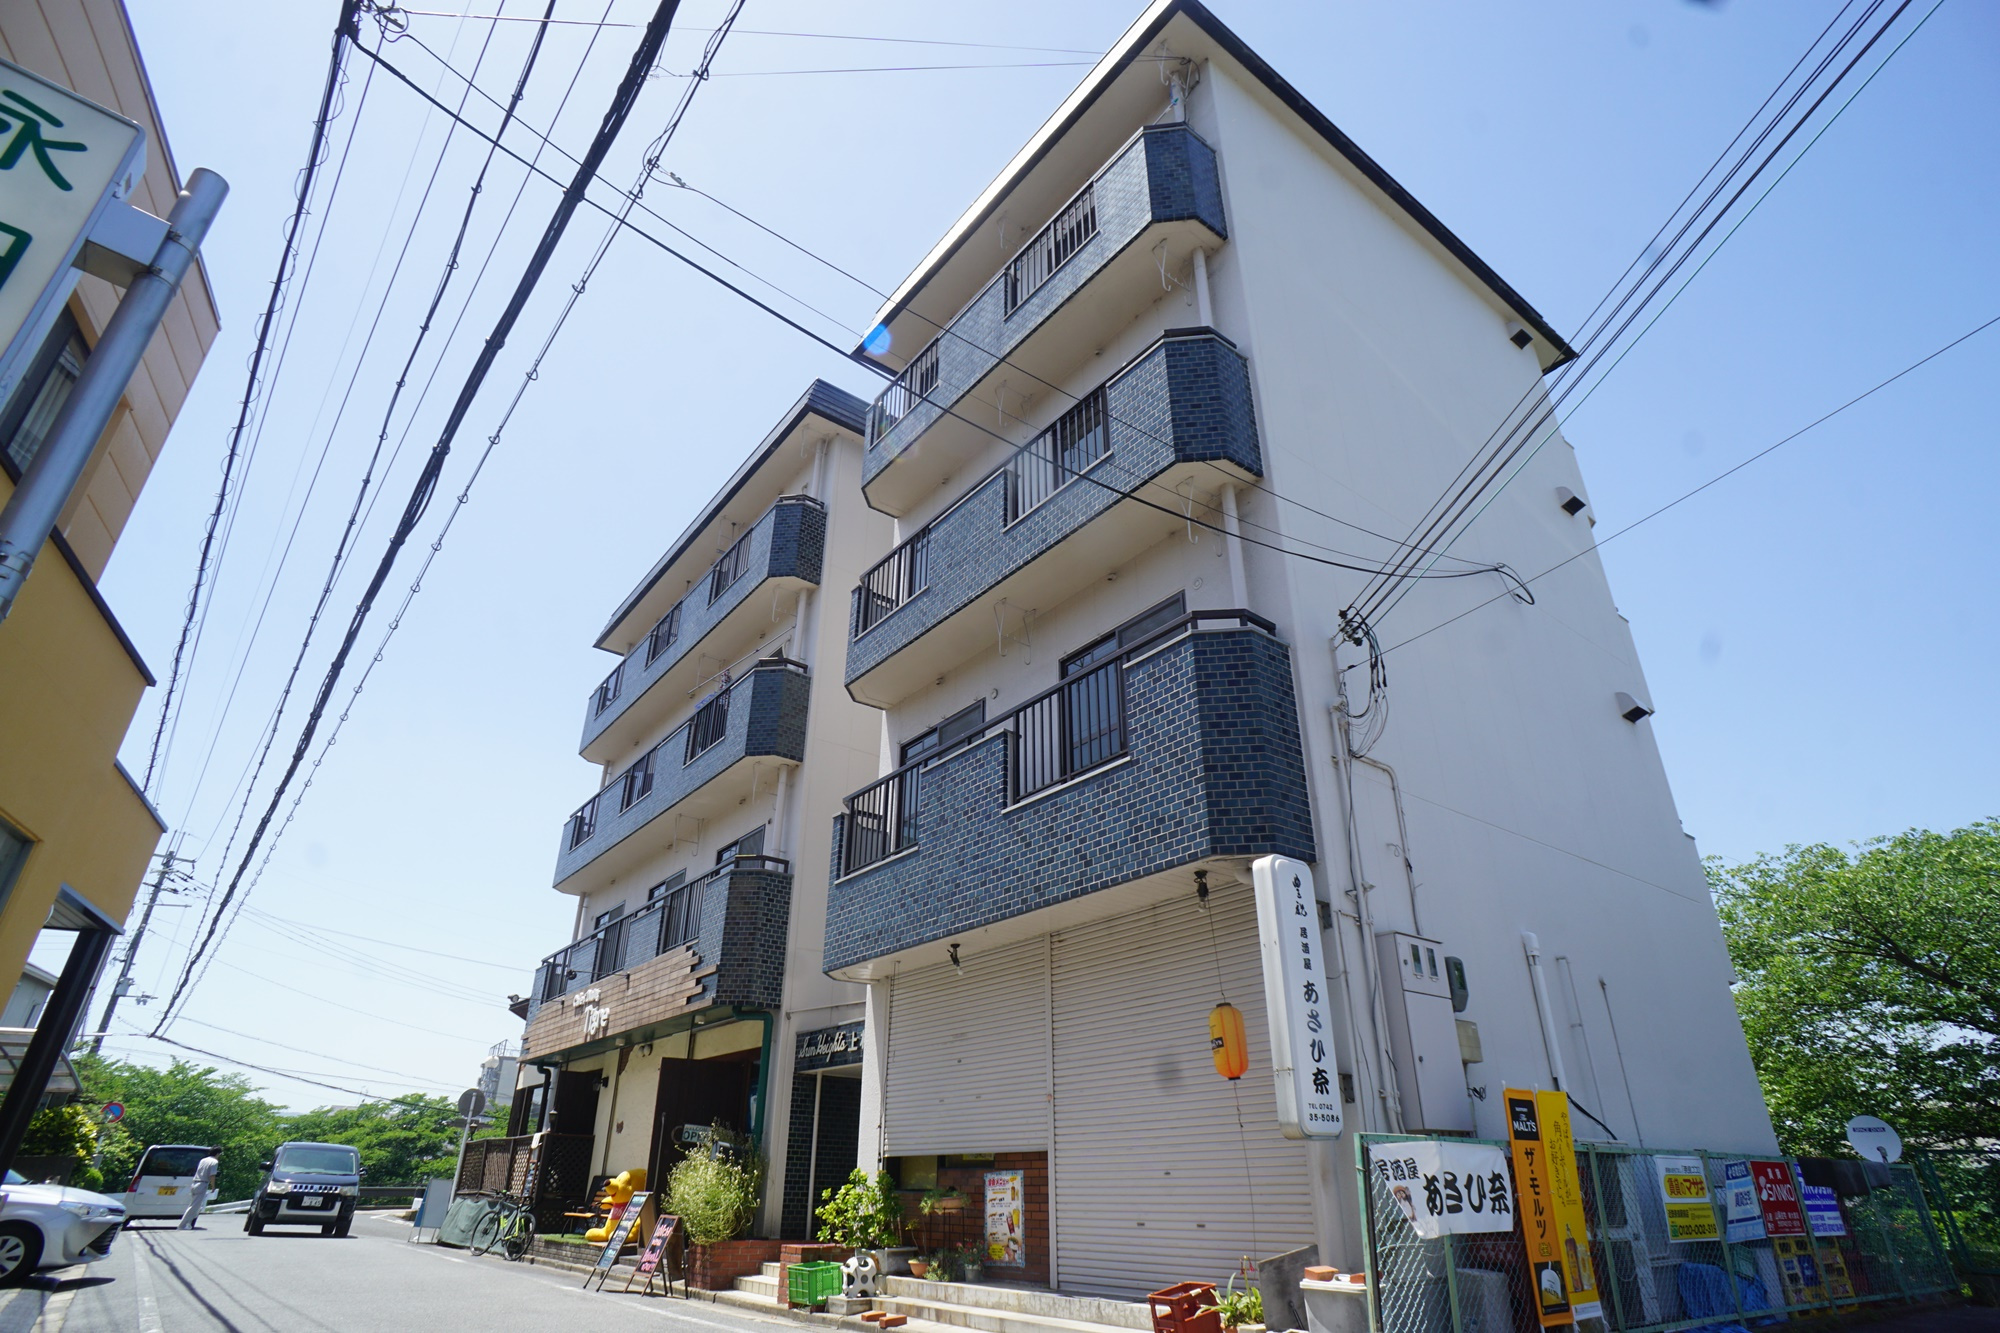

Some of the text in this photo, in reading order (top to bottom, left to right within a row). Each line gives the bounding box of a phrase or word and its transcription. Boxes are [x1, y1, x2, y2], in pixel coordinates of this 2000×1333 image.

[1299, 926, 1313, 971] 居酒屋
[815, 1031, 848, 1063] Heights
[1303, 980, 1330, 1095] あさひ奈
[1308, 1102, 1318, 1110] TEL
[1375, 1157, 1421, 1183] 居酒屋
[1422, 1170, 1511, 1217] あさひ奈
[1524, 1147, 1547, 1239] ザ・モルツ
[1765, 1183, 1796, 1202] SANKO
